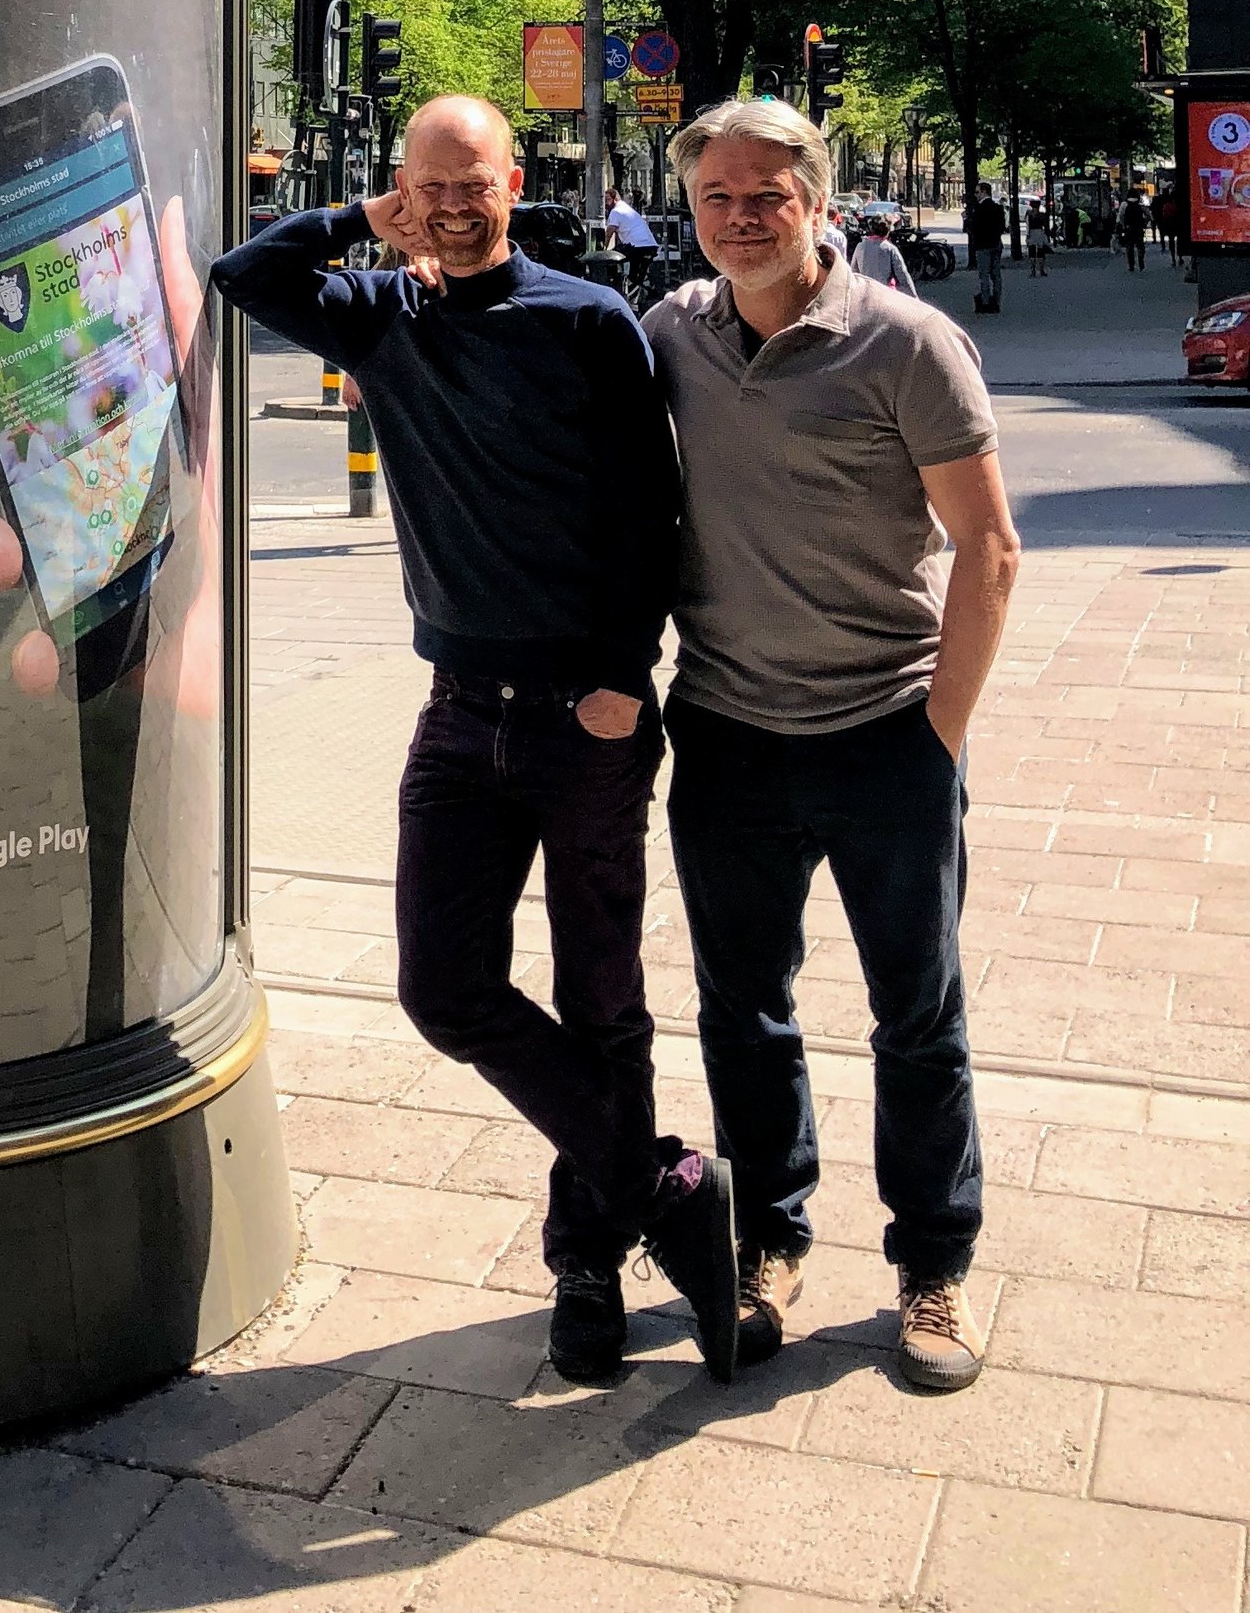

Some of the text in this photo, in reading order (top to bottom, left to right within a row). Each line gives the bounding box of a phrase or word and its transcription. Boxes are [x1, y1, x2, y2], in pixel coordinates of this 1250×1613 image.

[1222, 122, 1239, 143] 3
[0, 176, 50, 206] Stockholms
[50, 167, 70, 184] stad
[34, 224, 128, 283] Stockholms
[42, 268, 81, 303] stad
[39, 332, 54, 350] till
[53, 307, 112, 343] Stockholms
[39, 825, 90, 856] Play
